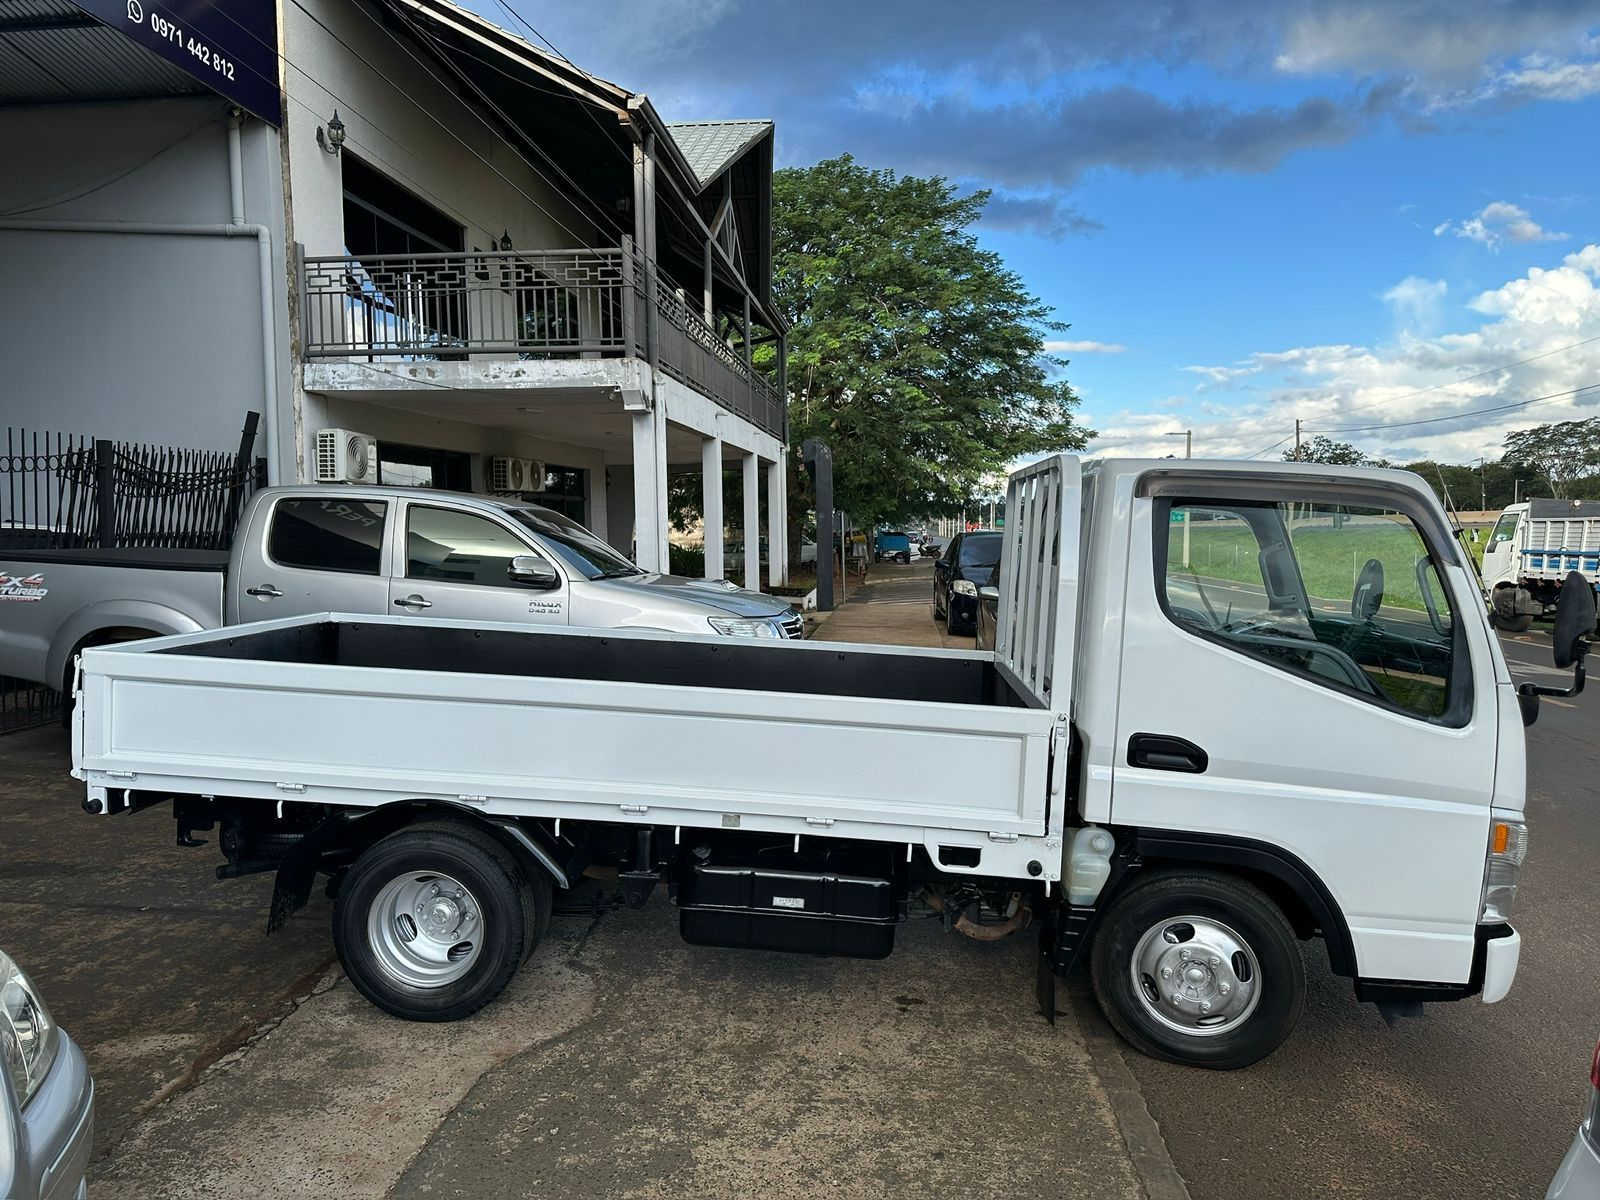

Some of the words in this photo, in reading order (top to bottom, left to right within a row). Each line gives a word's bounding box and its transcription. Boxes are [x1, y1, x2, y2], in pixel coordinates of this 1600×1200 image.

[151, 13, 182, 48] 0971
[187, 37, 210, 65] 442
[213, 53, 235, 81] 812
[0, 587, 48, 597] TURBO
[529, 600, 562, 608] HILUX
